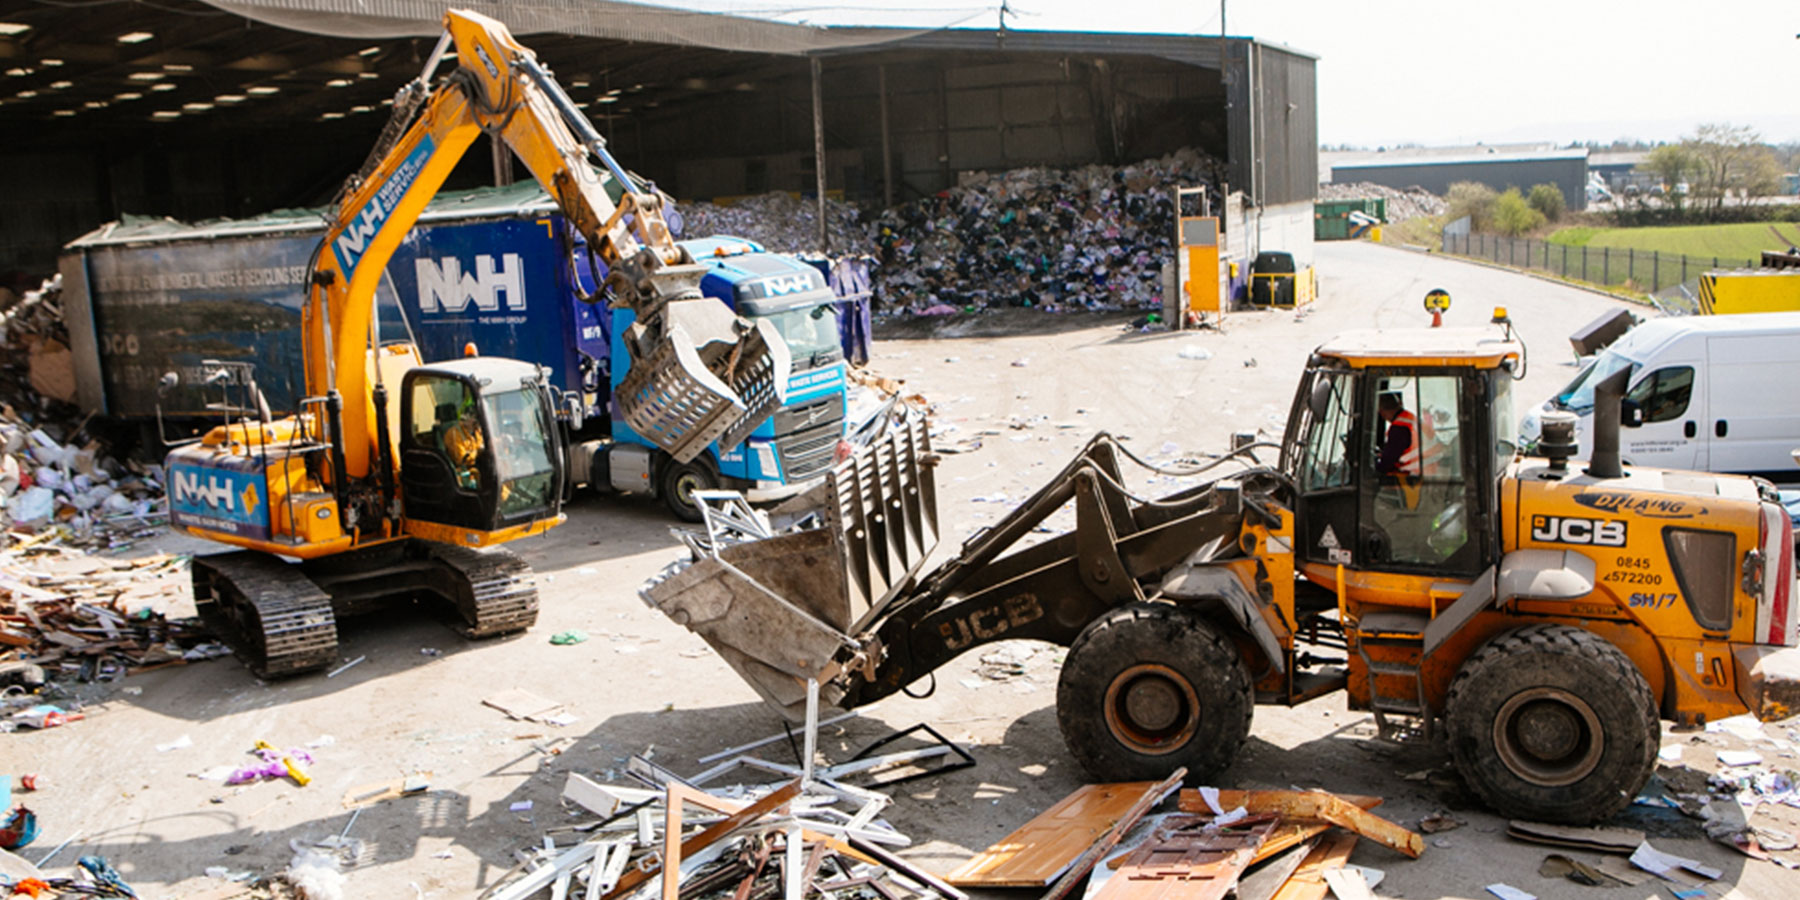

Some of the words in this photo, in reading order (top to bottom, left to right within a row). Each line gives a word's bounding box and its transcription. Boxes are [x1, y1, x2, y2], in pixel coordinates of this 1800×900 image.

[378, 160, 411, 200] WASTE
[337, 196, 385, 268] NWH
[290, 265, 308, 285] SER
[415, 253, 527, 313] NWH
[763, 274, 814, 298] NWH
[174, 470, 235, 513] NWH
[1533, 516, 1626, 546] JCB
[1603, 571, 1663, 585] 2572200
[1616, 556, 1651, 570] 0845
[939, 592, 1044, 650] JCB
